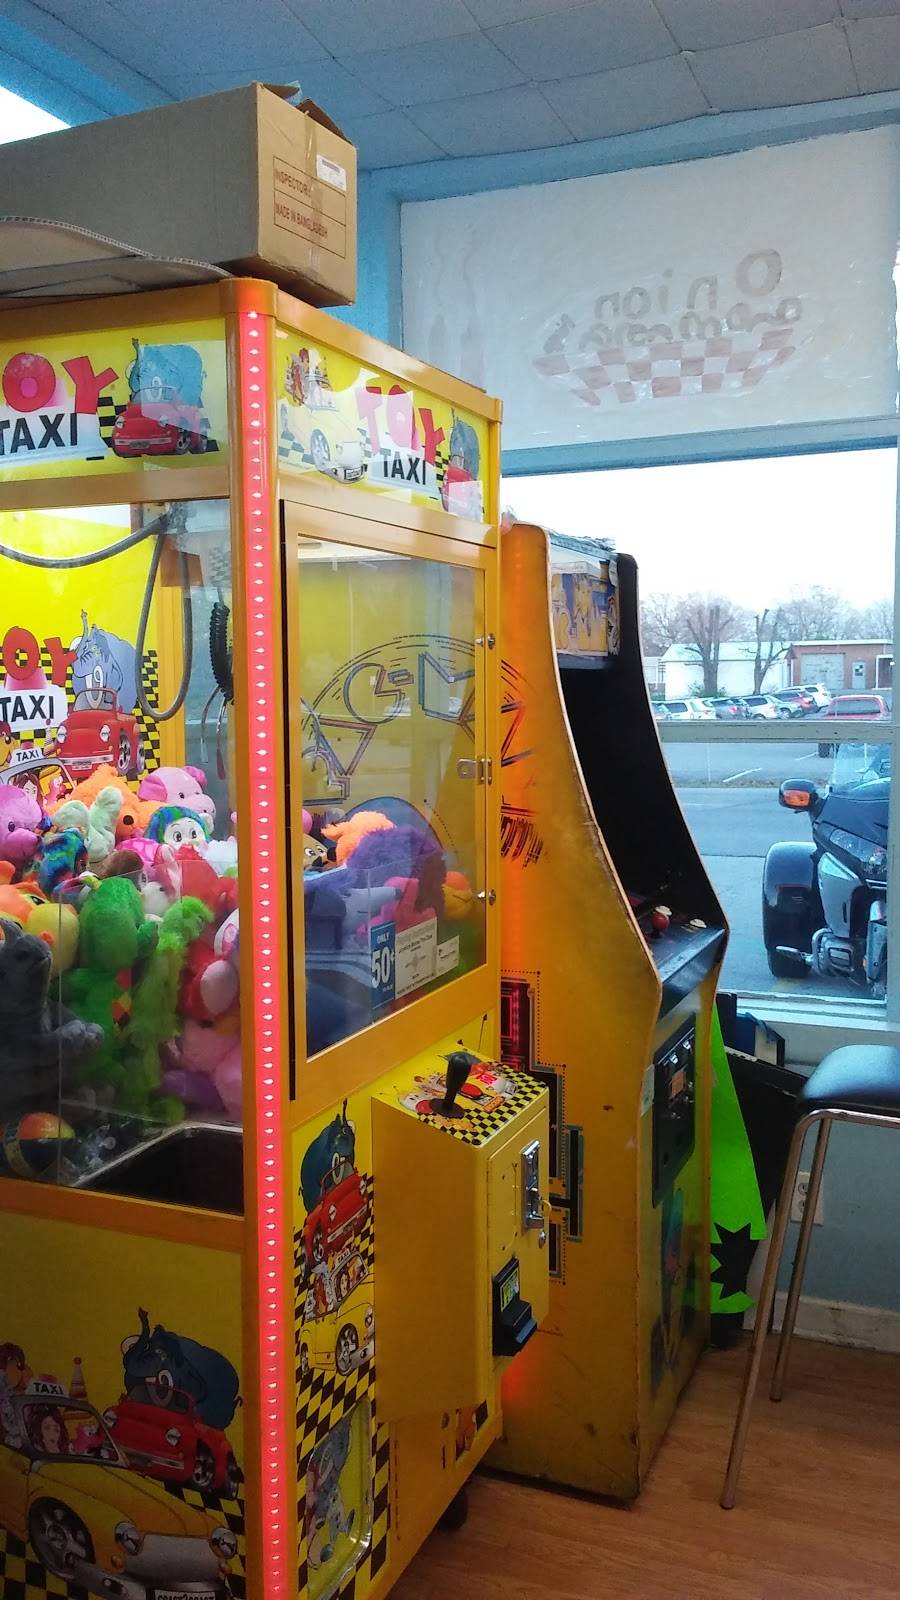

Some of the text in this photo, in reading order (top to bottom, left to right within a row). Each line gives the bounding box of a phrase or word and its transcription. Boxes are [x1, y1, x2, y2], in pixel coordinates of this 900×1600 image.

[274, 203, 290, 220] MADE
[0, 413, 78, 456] TAXI
[354, 384, 446, 467] TOY
[380, 447, 426, 486] TAXI
[0, 695, 54, 723] TAXI
[16, 749, 39, 762] TAXI
[33, 1382, 64, 1395] TAXI
